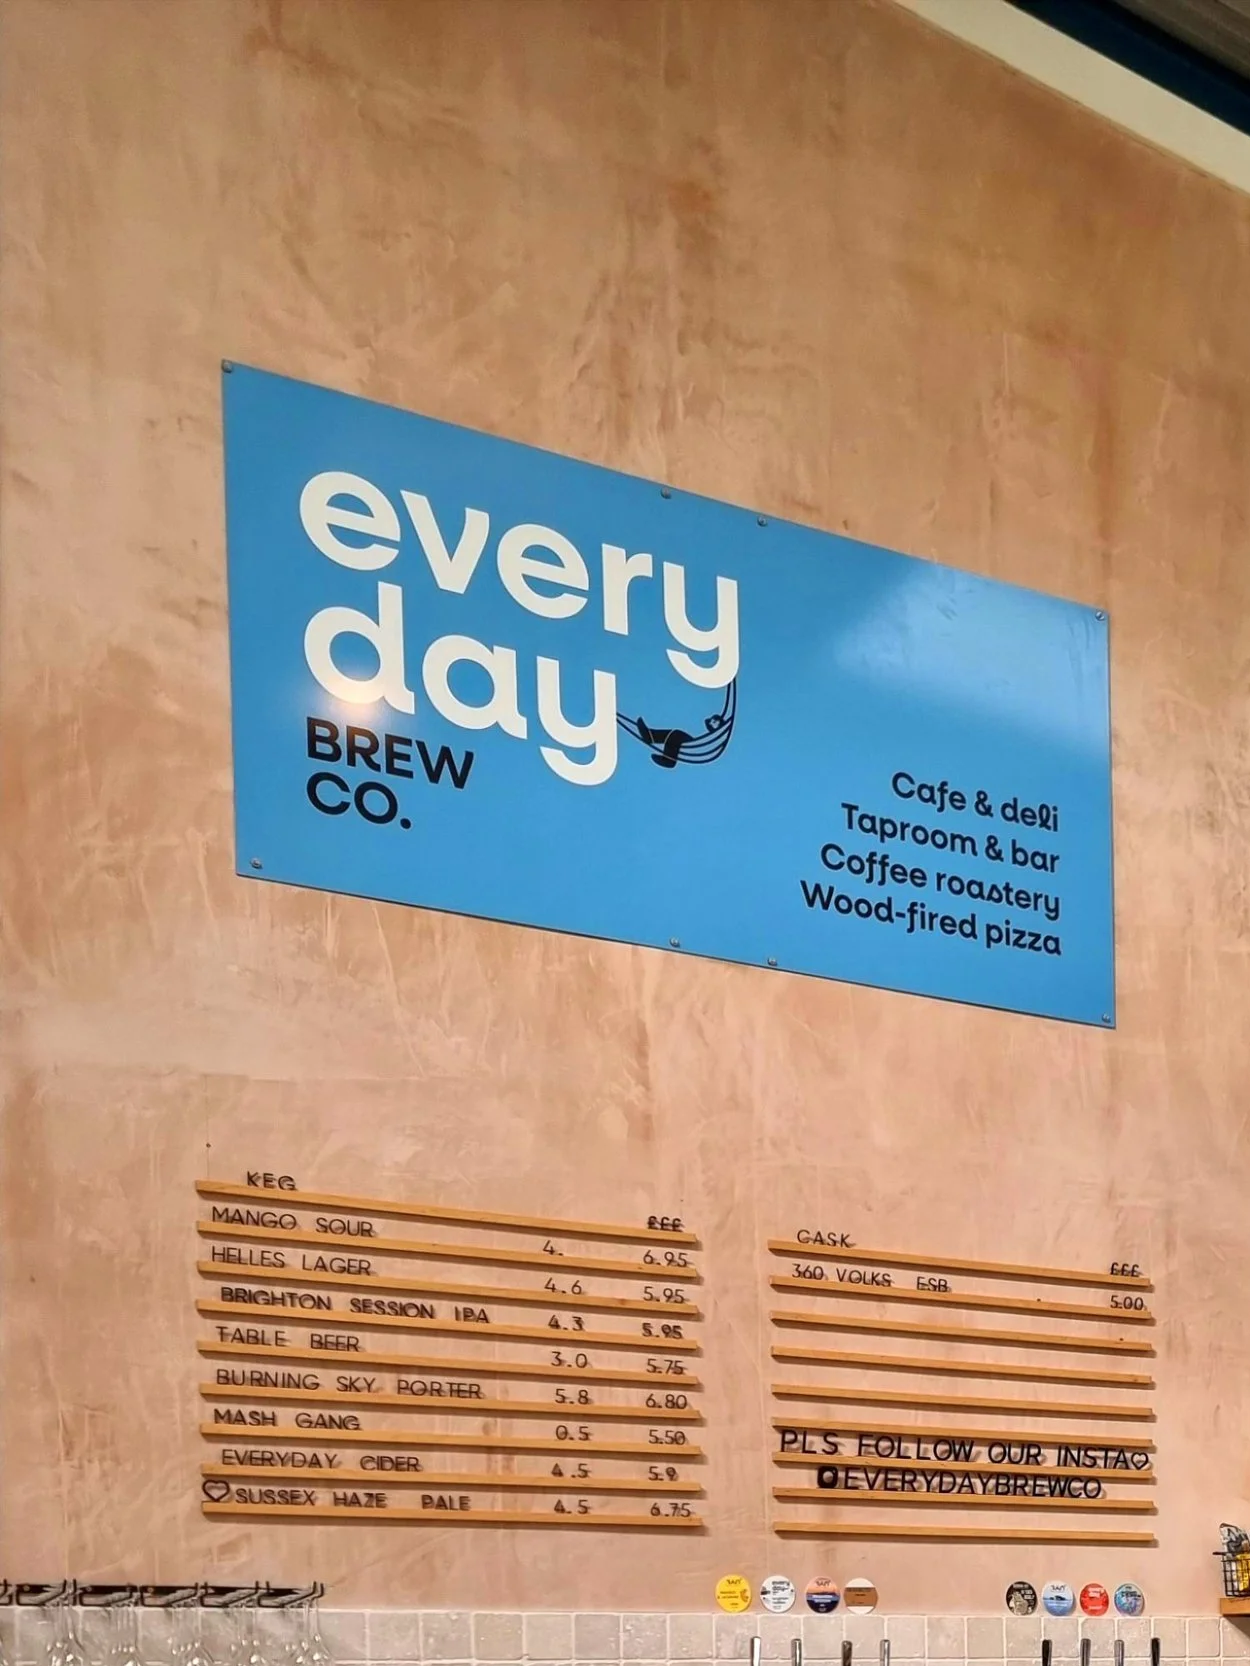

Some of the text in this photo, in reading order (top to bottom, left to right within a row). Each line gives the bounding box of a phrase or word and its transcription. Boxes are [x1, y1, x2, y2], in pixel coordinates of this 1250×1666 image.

[300, 471, 740, 689] every
[303, 581, 618, 786] day
[306, 716, 475, 790] BREW
[306, 771, 412, 829] CO.
[892, 772, 1059, 832] Cafe & deli
[841, 802, 1060, 873] Taproom & bar
[820, 843, 1060, 921] Coffee roastery
[800, 880, 1061, 956] Wood-fired pizza
[246, 1171, 296, 1191] KEG
[212, 1206, 297, 1230] MANGO
[316, 1217, 373, 1238] SOUR
[643, 1250, 688, 1267] 6.95
[797, 1230, 851, 1248] CASK
[211, 1246, 685, 1304] HELLES LAGER 4.6 5.95
[792, 1263, 824, 1280] 360
[836, 1268, 891, 1287] VOLKS
[1110, 1294, 1144, 1311] 5.00
[221, 1286, 684, 1339] BRIGHTON SESSION IPA 4.3 5.95
[215, 1326, 684, 1375] TABLE BEER 3.0 5.75
[216, 1368, 687, 1409] BURNING SKY PORTER 5.8 6.80
[214, 1408, 686, 1445] MASH GANG 0.5 5.50
[780, 1429, 1129, 1470] PLS FOLLOW OUR INSTA
[221, 1449, 337, 1468] EVERYDAY
[360, 1455, 420, 1472] CIDER
[844, 1466, 1102, 1499] EVERYDAYBREWCO
[235, 1488, 691, 1517] SUSSEX HAZE PALE 4.5 6.75
